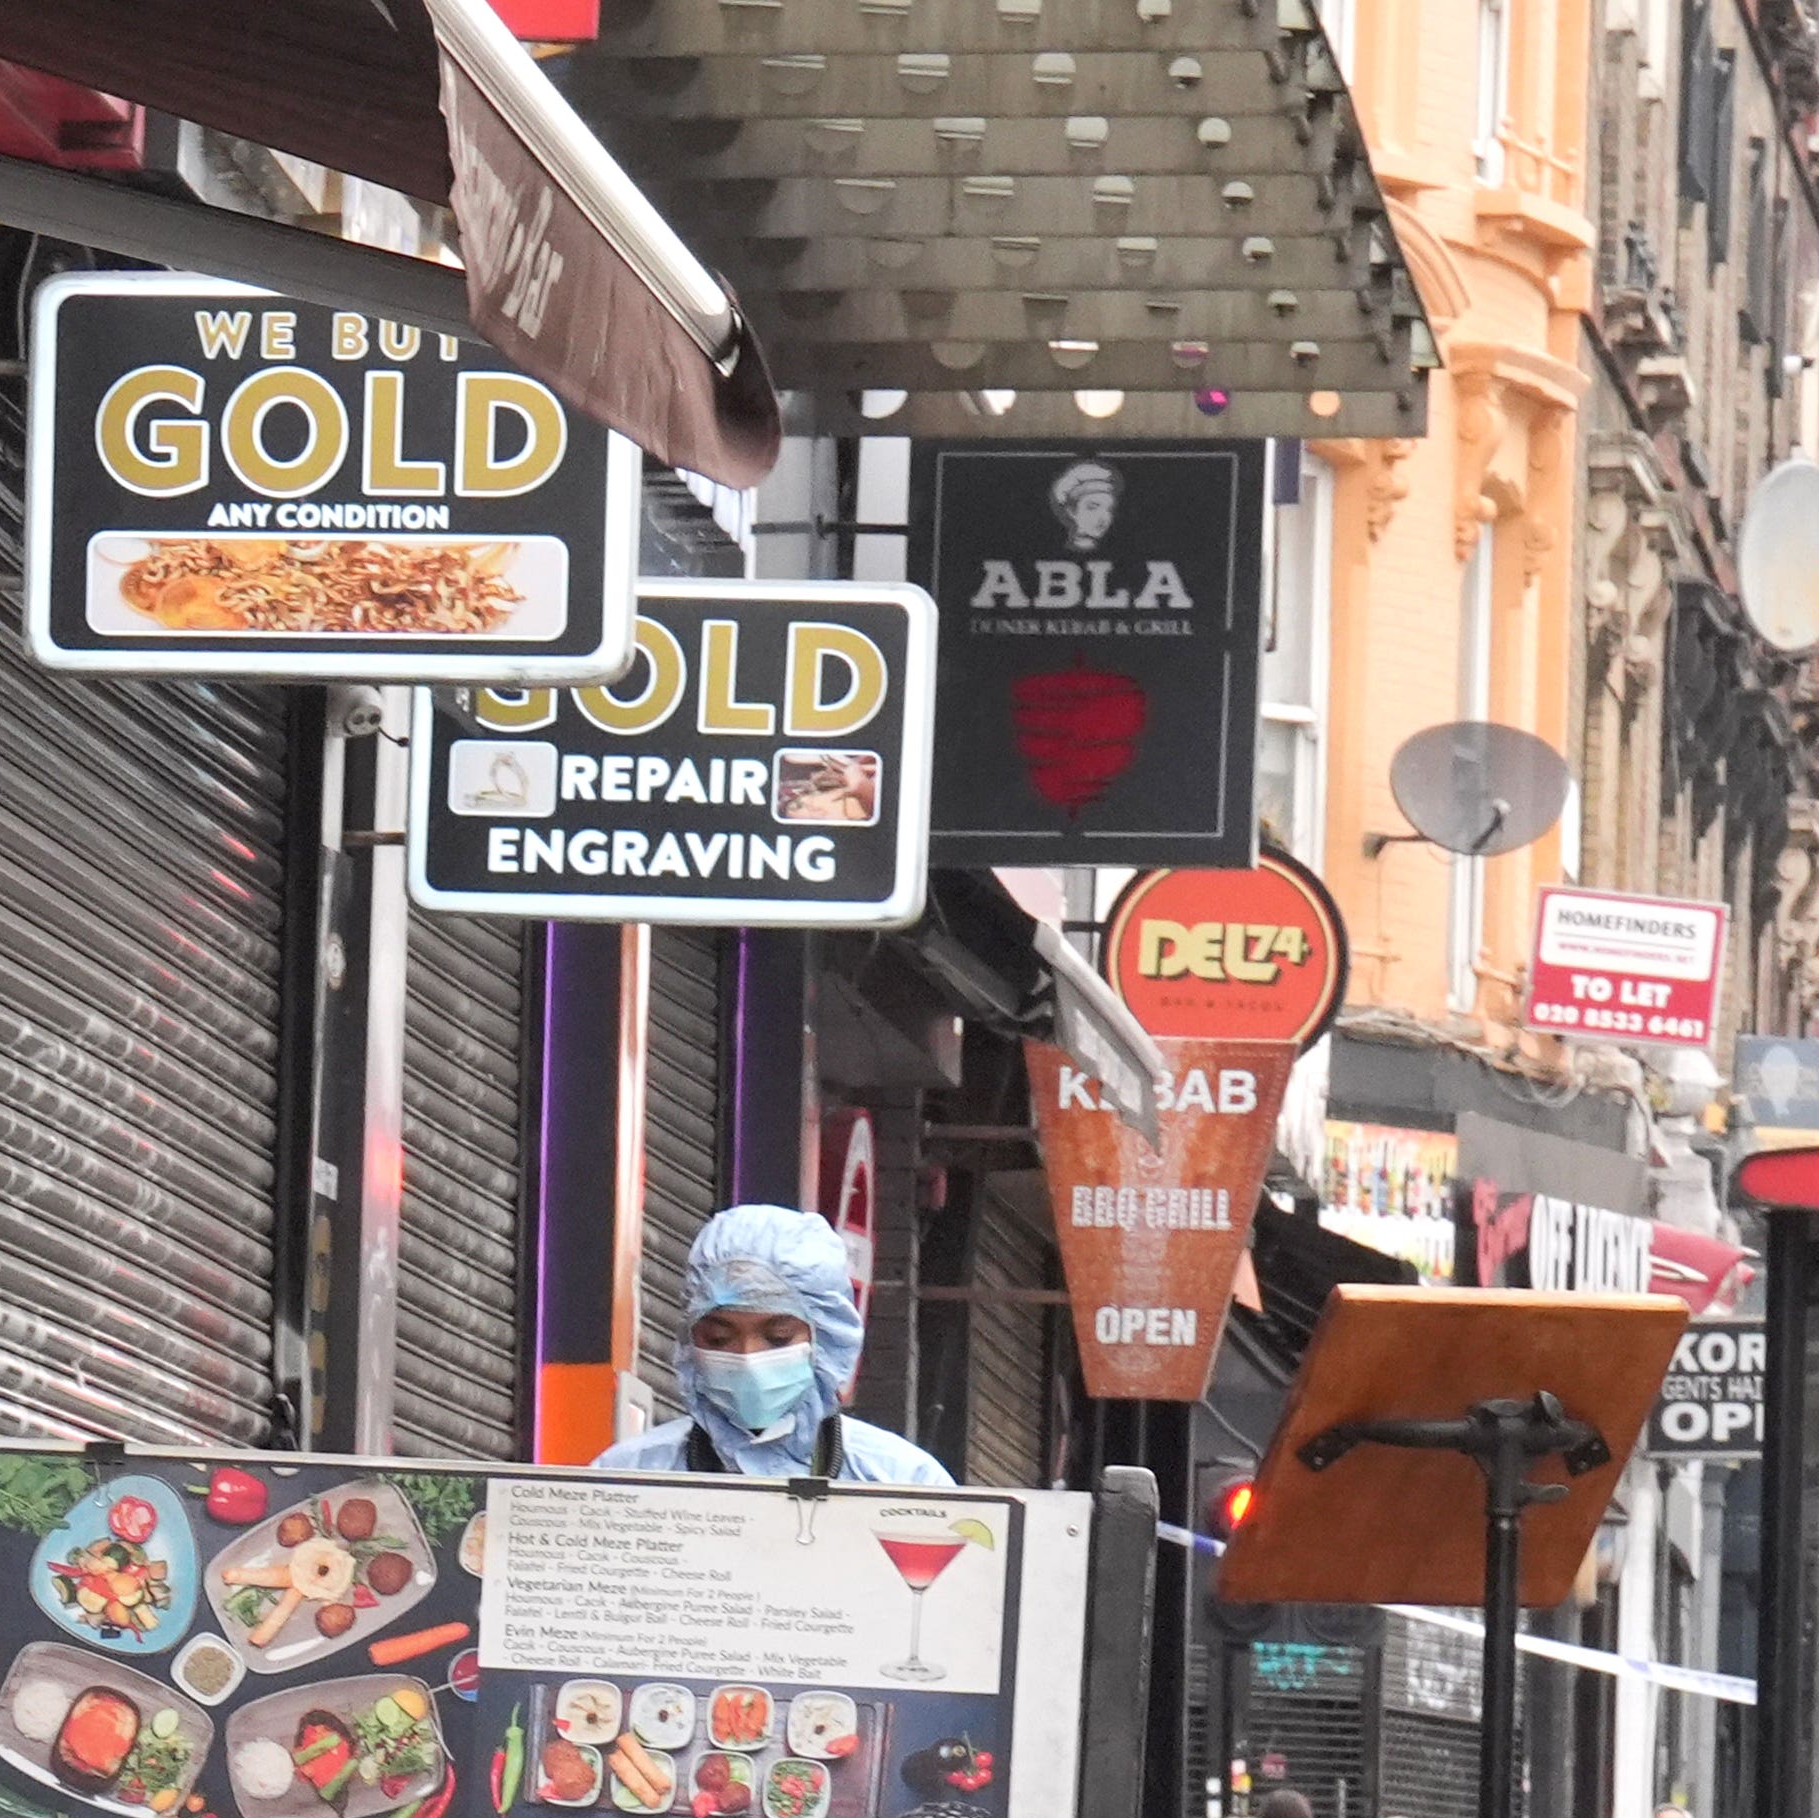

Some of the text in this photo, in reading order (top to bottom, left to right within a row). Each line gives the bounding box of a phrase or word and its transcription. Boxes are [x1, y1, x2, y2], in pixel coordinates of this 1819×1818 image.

[195, 311, 297, 361] WE
[95, 365, 568, 499] GOLD
[207, 502, 450, 530] ANY CONDITION
[970, 560, 1193, 609] ABLA
[561, 755, 768, 806] REPAIR
[488, 827, 836, 883] ENGRAVING
[1557, 909, 1697, 940] HOMEFINDERS
[1571, 974, 1673, 1009] TO LET
[1533, 1003, 1580, 1025] 020
[1583, 1008, 1644, 1032] 8533
[1058, 1064, 1258, 1115] KBAB
[1071, 1184, 1233, 1232] BBQ GRILL
[1095, 1305, 1197, 1347] OPEN
[1661, 1375, 1723, 1401] GENTS
[511, 1485, 640, 1503] Cold Meze Platter
[605, 1519, 663, 1534] Vegetable
[710, 1525, 741, 1537] Salad
[508, 1532, 684, 1553] Hot & Cold Meze Platter
[506, 1577, 583, 1593] Vegetarian
[588, 1581, 627, 1595] Meze
[590, 1563, 650, 1579] Courgette
[661, 1567, 706, 1581] Cheese
[679, 1614, 723, 1627] Cheese
[761, 1618, 791, 1631] Fried
[794, 1620, 855, 1635] Courgette
[721, 1602, 753, 1615] Salad
[810, 1607, 843, 1620] Salad
[540, 1626, 579, 1640] Meze
[719, 1649, 751, 1662] Salad
[788, 1653, 848, 1668] Vegetable
